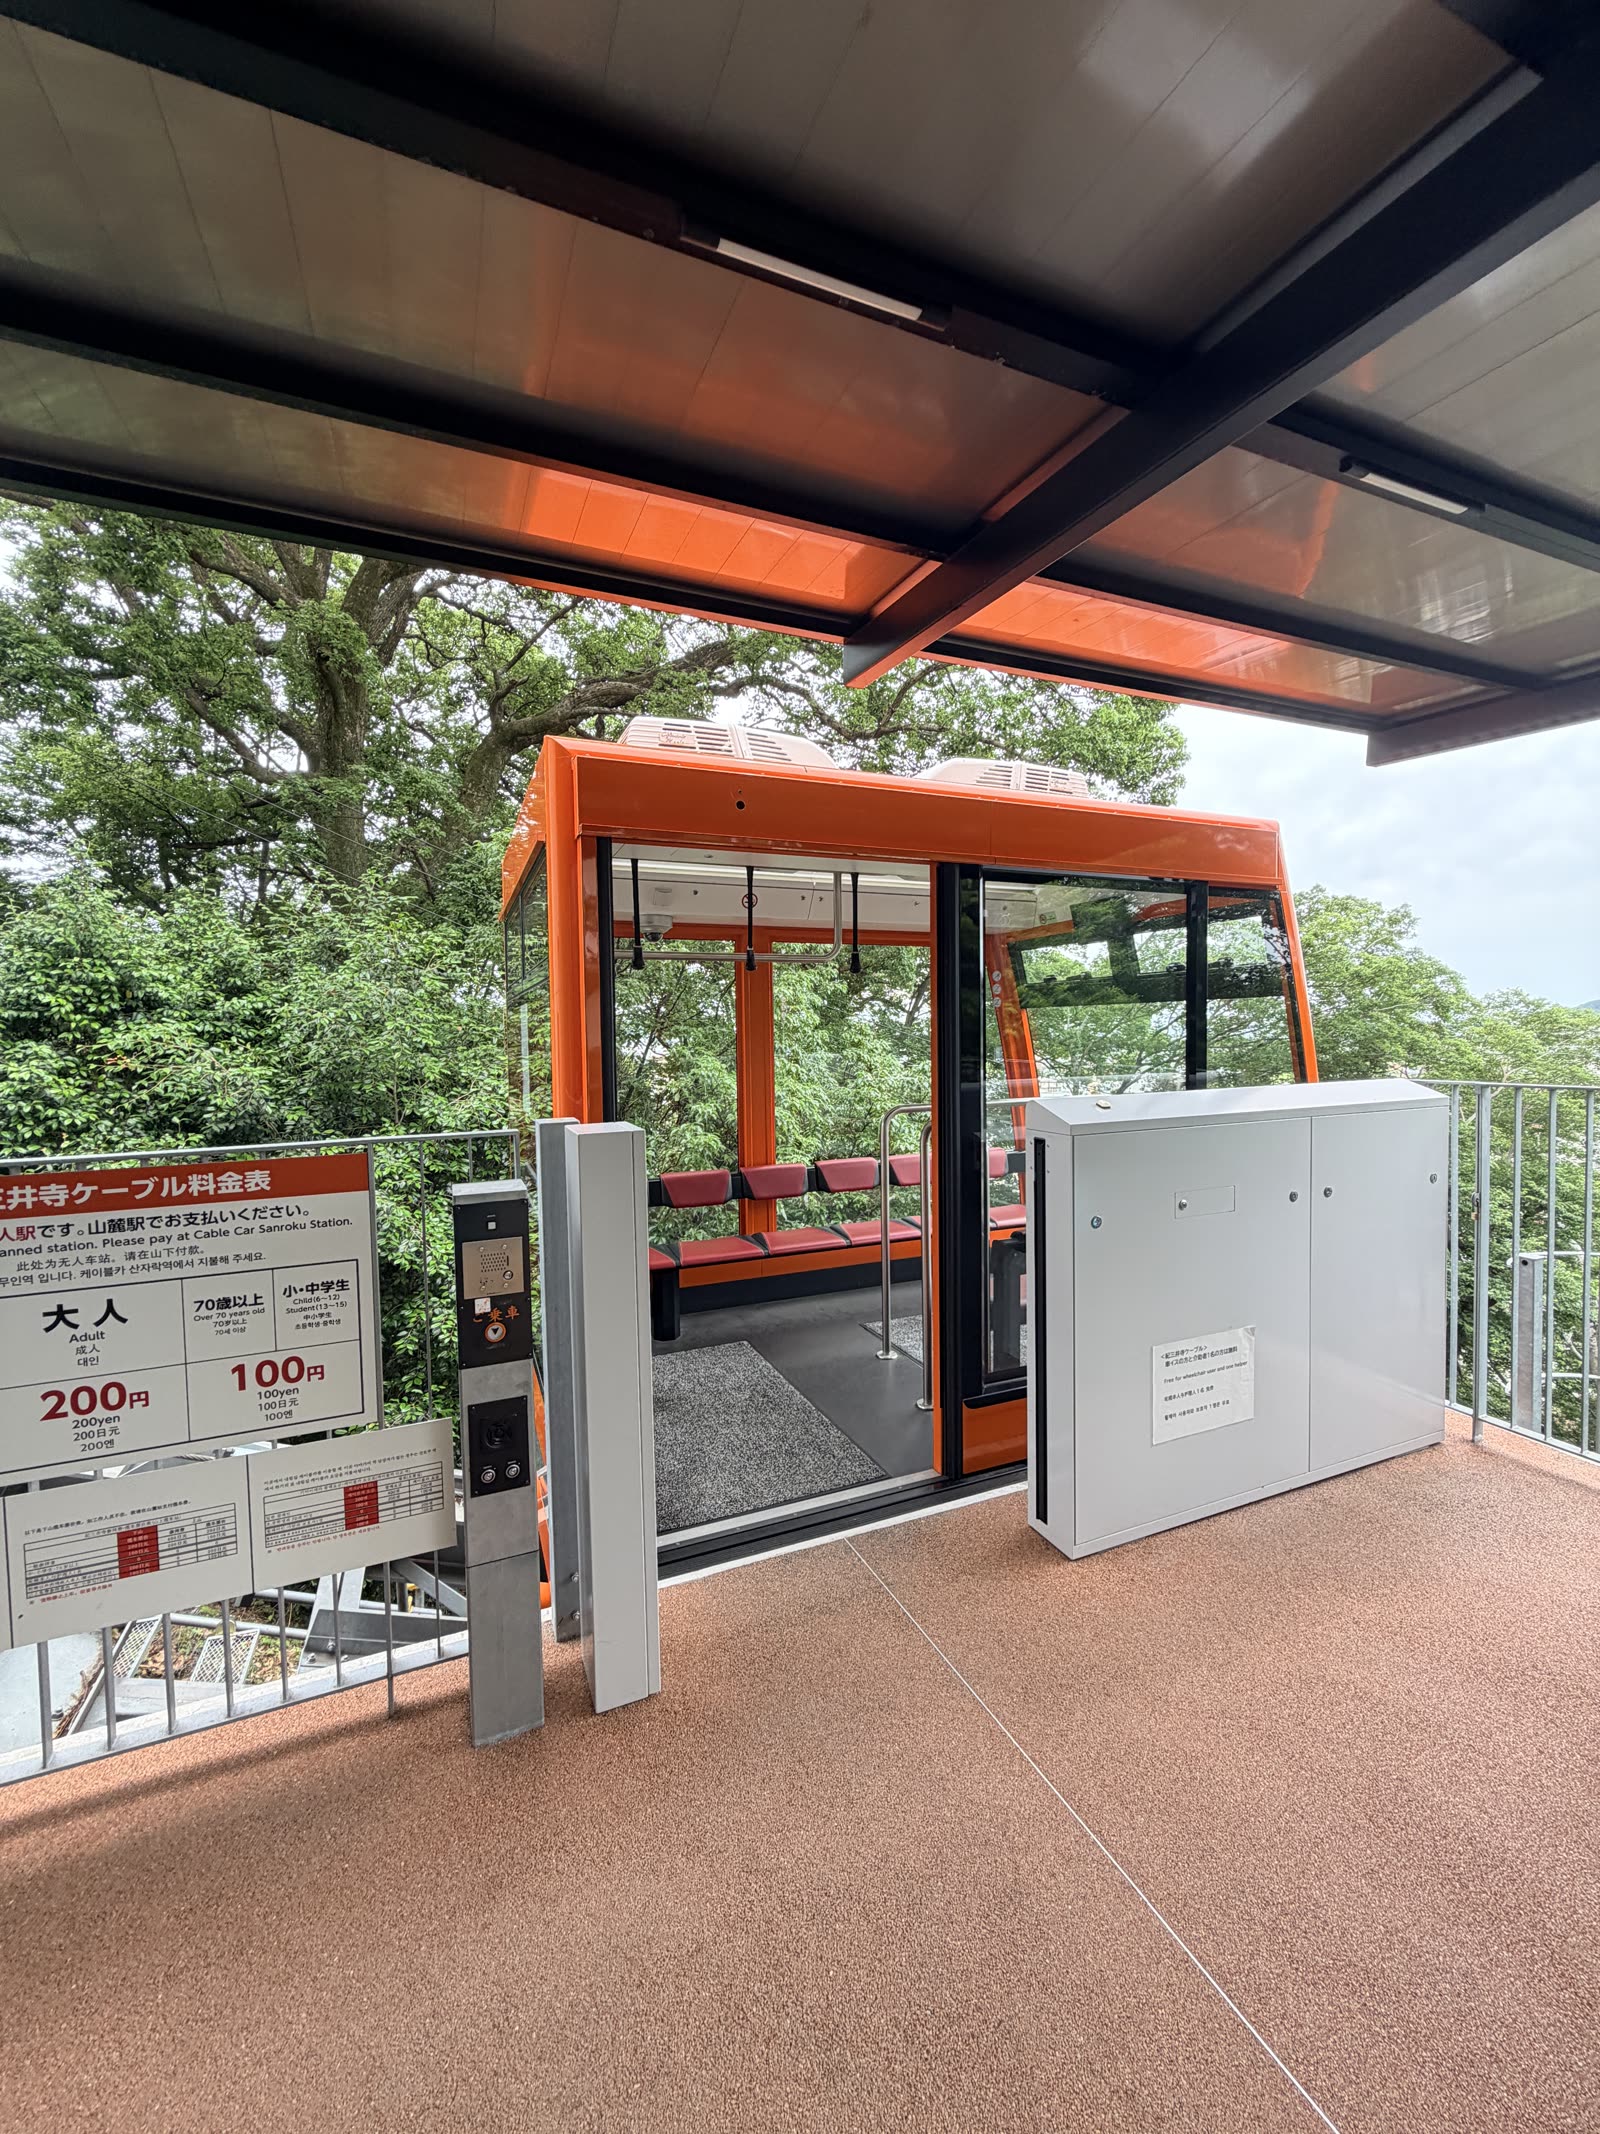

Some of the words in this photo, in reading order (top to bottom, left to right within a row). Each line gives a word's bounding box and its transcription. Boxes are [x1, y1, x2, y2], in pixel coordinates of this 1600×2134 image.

[0, 1169, 271, 1211] 井寺ケーブル料金表
[47, 1241, 98, 1253] station.
[102, 1236, 145, 1248] Please
[150, 1234, 173, 1248] pay
[177, 1231, 190, 1241] at
[194, 1228, 230, 1240] Cable
[234, 1226, 255, 1236] Car
[258, 1221, 307, 1234] Sanroku
[310, 1217, 353, 1229] Station.
[38, 1271, 77, 1284] 입니다.
[80, 1265, 126, 1279] 케이블카
[198, 1255, 229, 1267] 지불해
[232, 1252, 267, 1264] 주세요.
[193, 1293, 264, 1312] 70歳以上
[229, 1310, 250, 1319] years
[69, 1331, 105, 1343] Adult
[75, 1344, 101, 1355] 成人
[77, 1356, 99, 1367] 대인
[231, 1355, 325, 1392] 100円
[257, 1388, 299, 1400] 100yen
[40, 1381, 149, 1422] 200円
[258, 1398, 299, 1411] 100日元
[265, 1409, 293, 1421] 100엔
[72, 1415, 120, 1430] 200yen
[73, 1427, 120, 1441] 200日元
[80, 1439, 115, 1452] 200엔
